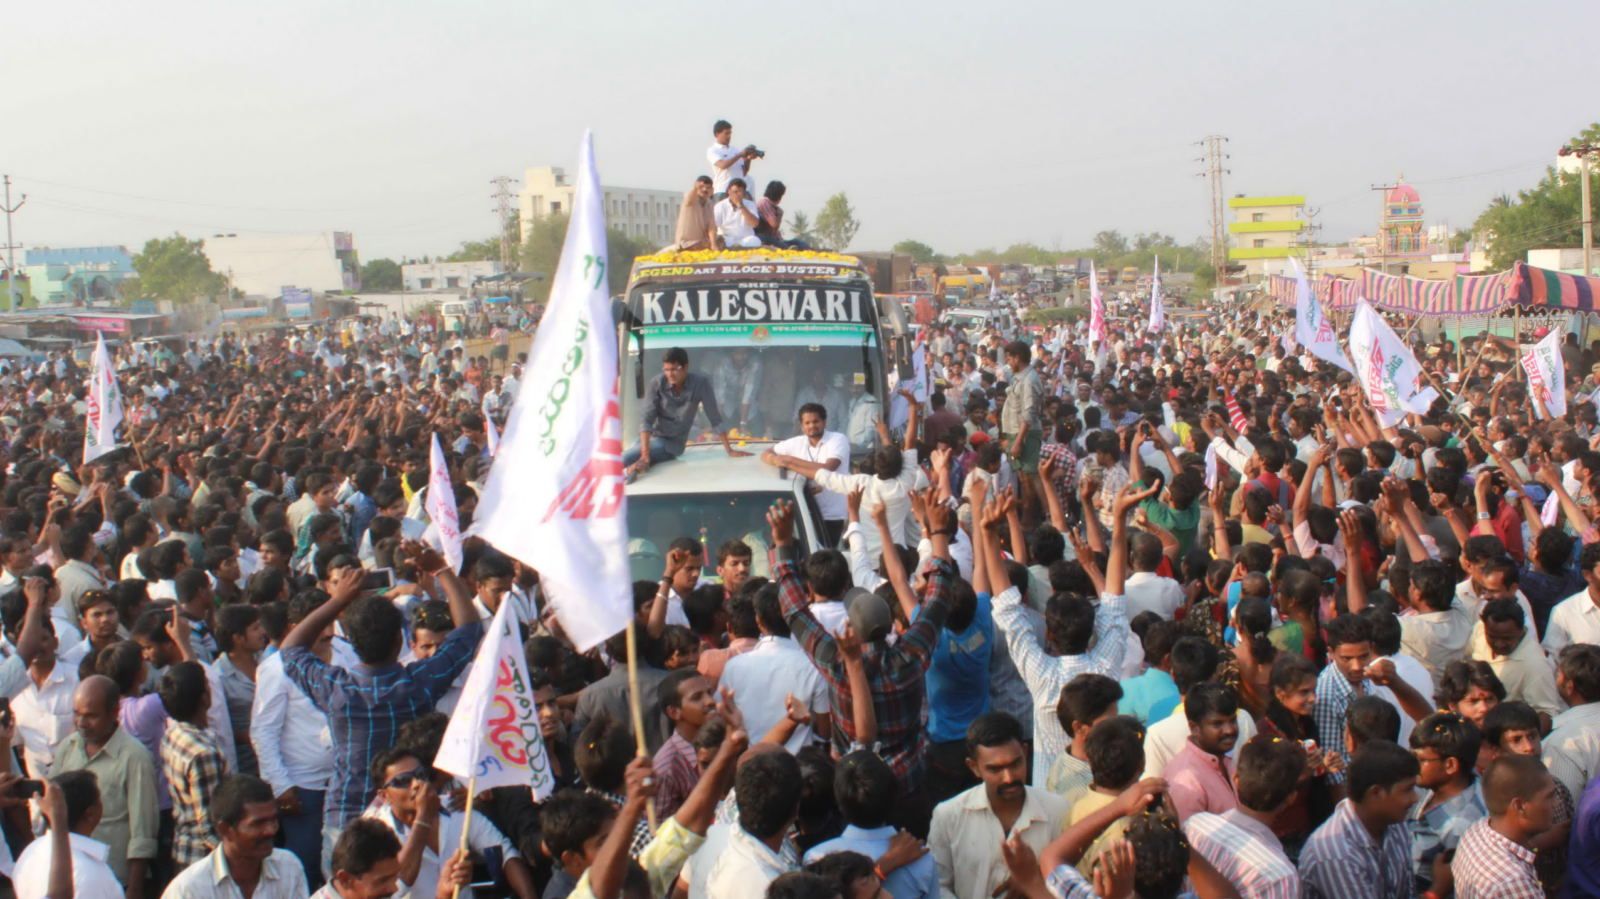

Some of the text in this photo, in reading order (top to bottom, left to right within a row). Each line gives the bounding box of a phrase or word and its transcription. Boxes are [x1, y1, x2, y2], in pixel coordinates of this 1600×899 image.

[721, 264, 773, 275] BLOCK
[775, 265, 836, 275] BUSTER
[642, 289, 862, 324] KALESWARI
